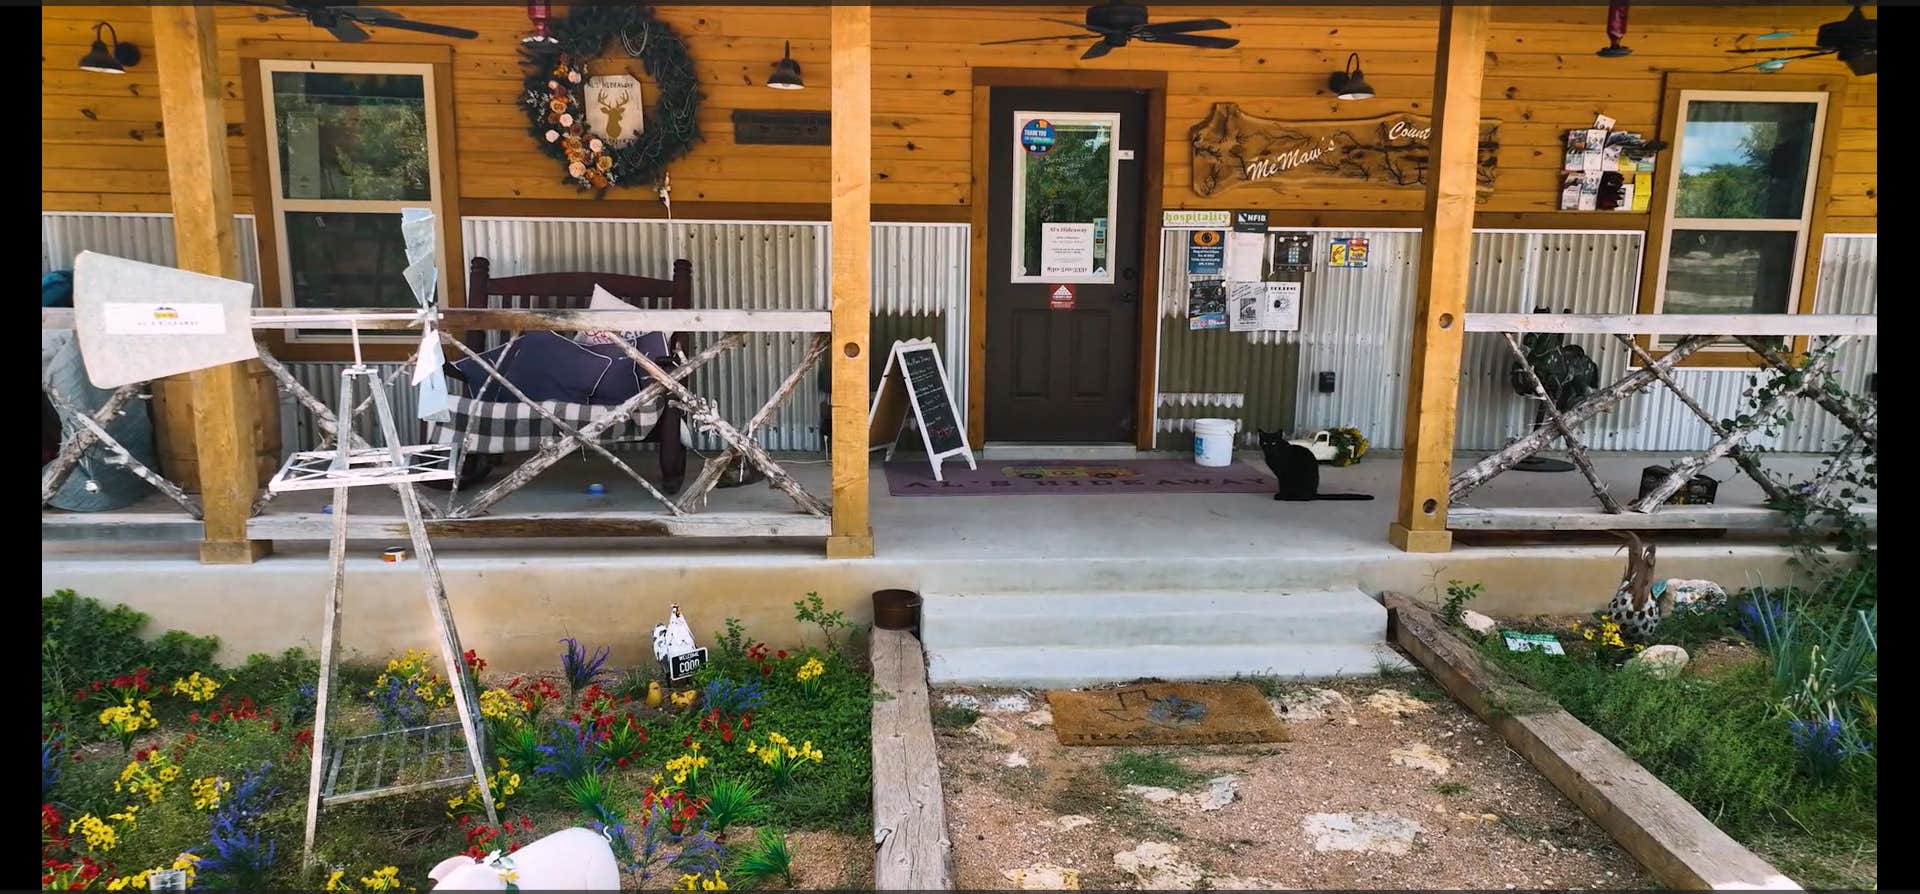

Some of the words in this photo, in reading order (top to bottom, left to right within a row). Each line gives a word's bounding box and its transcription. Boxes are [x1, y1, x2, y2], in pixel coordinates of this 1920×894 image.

[1388, 121, 1432, 140] Count
[1164, 211, 1229, 224] hospitality
[1247, 214, 1267, 223] NFIB
